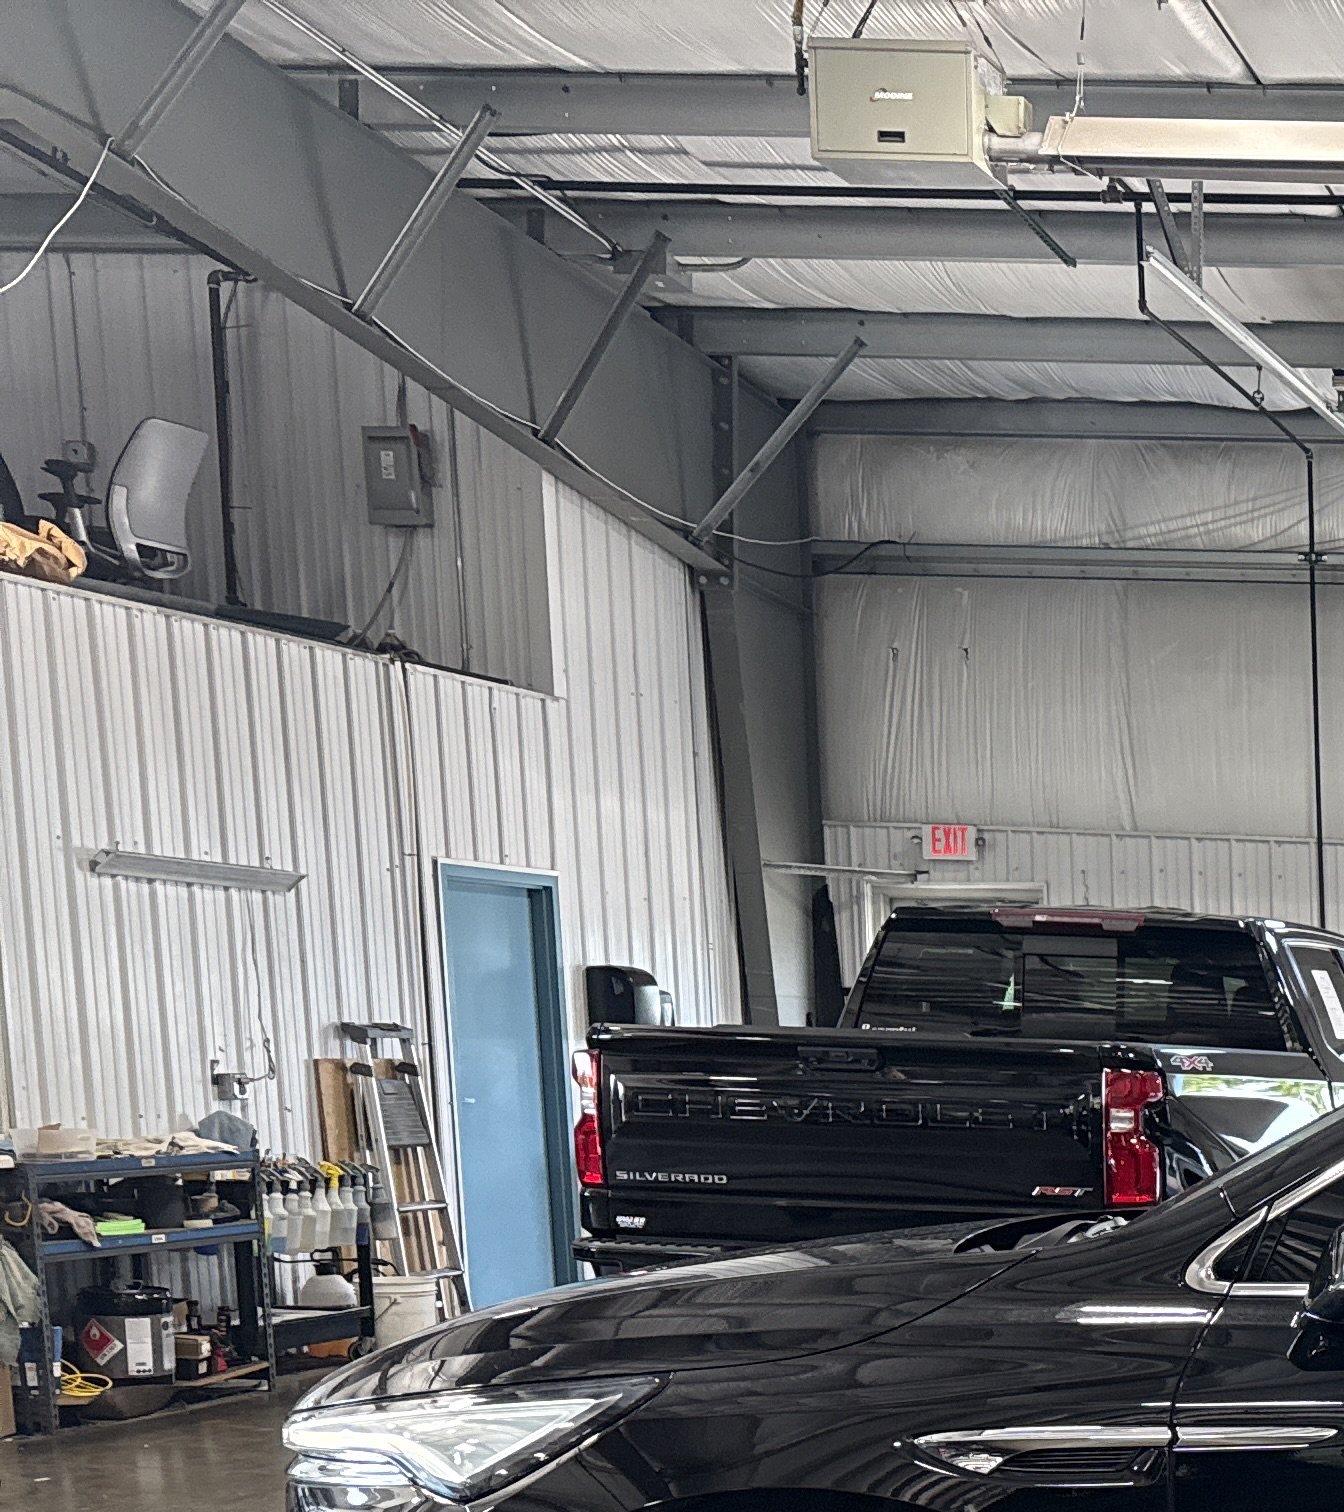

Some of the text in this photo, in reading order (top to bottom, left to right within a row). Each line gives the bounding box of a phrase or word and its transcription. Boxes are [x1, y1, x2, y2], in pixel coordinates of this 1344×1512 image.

[931, 825, 968, 856] EXIT
[632, 1092, 1056, 1131] CHEVROLET
[615, 1170, 728, 1184] SILVERADO
[1031, 1186, 1094, 1198] RST
